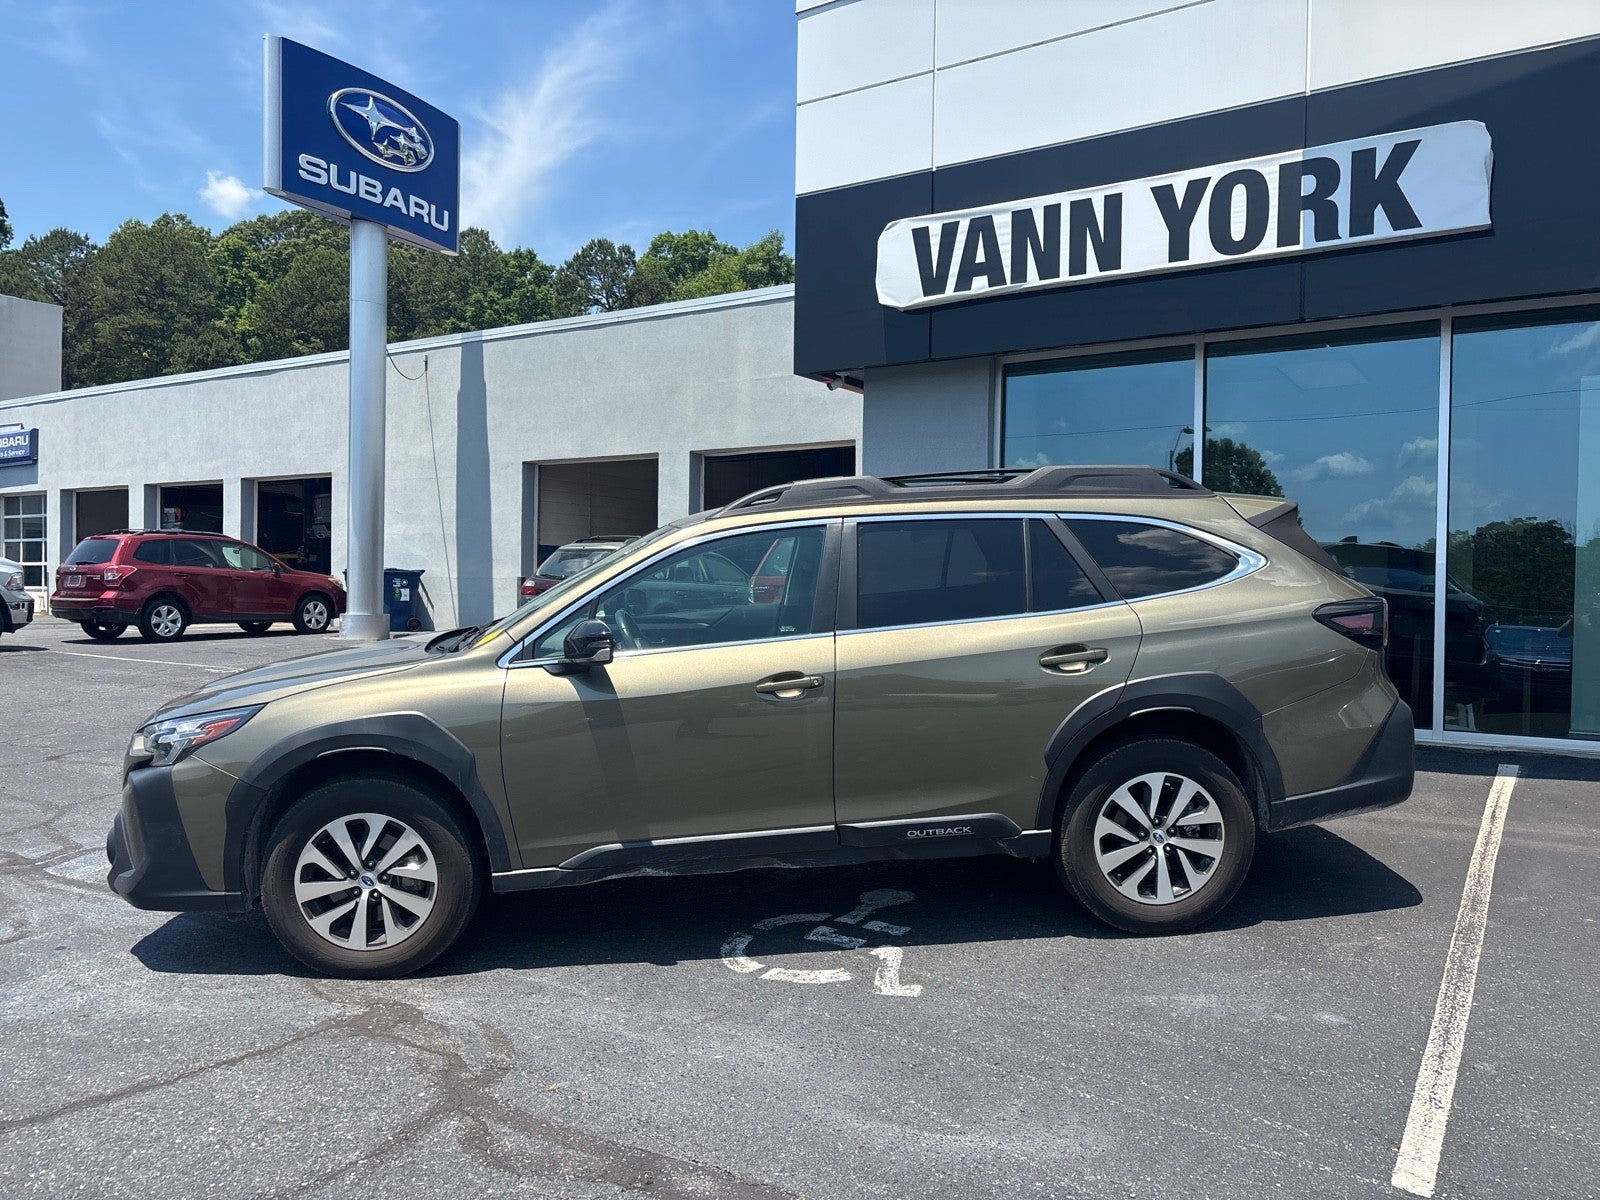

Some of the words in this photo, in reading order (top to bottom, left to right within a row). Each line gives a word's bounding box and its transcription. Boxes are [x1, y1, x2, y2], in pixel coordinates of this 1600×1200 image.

[298, 153, 449, 232] SUBARU
[911, 192, 1123, 298] VANN
[1150, 139, 1423, 263] YORK
[906, 826, 972, 837] OUTBACK
